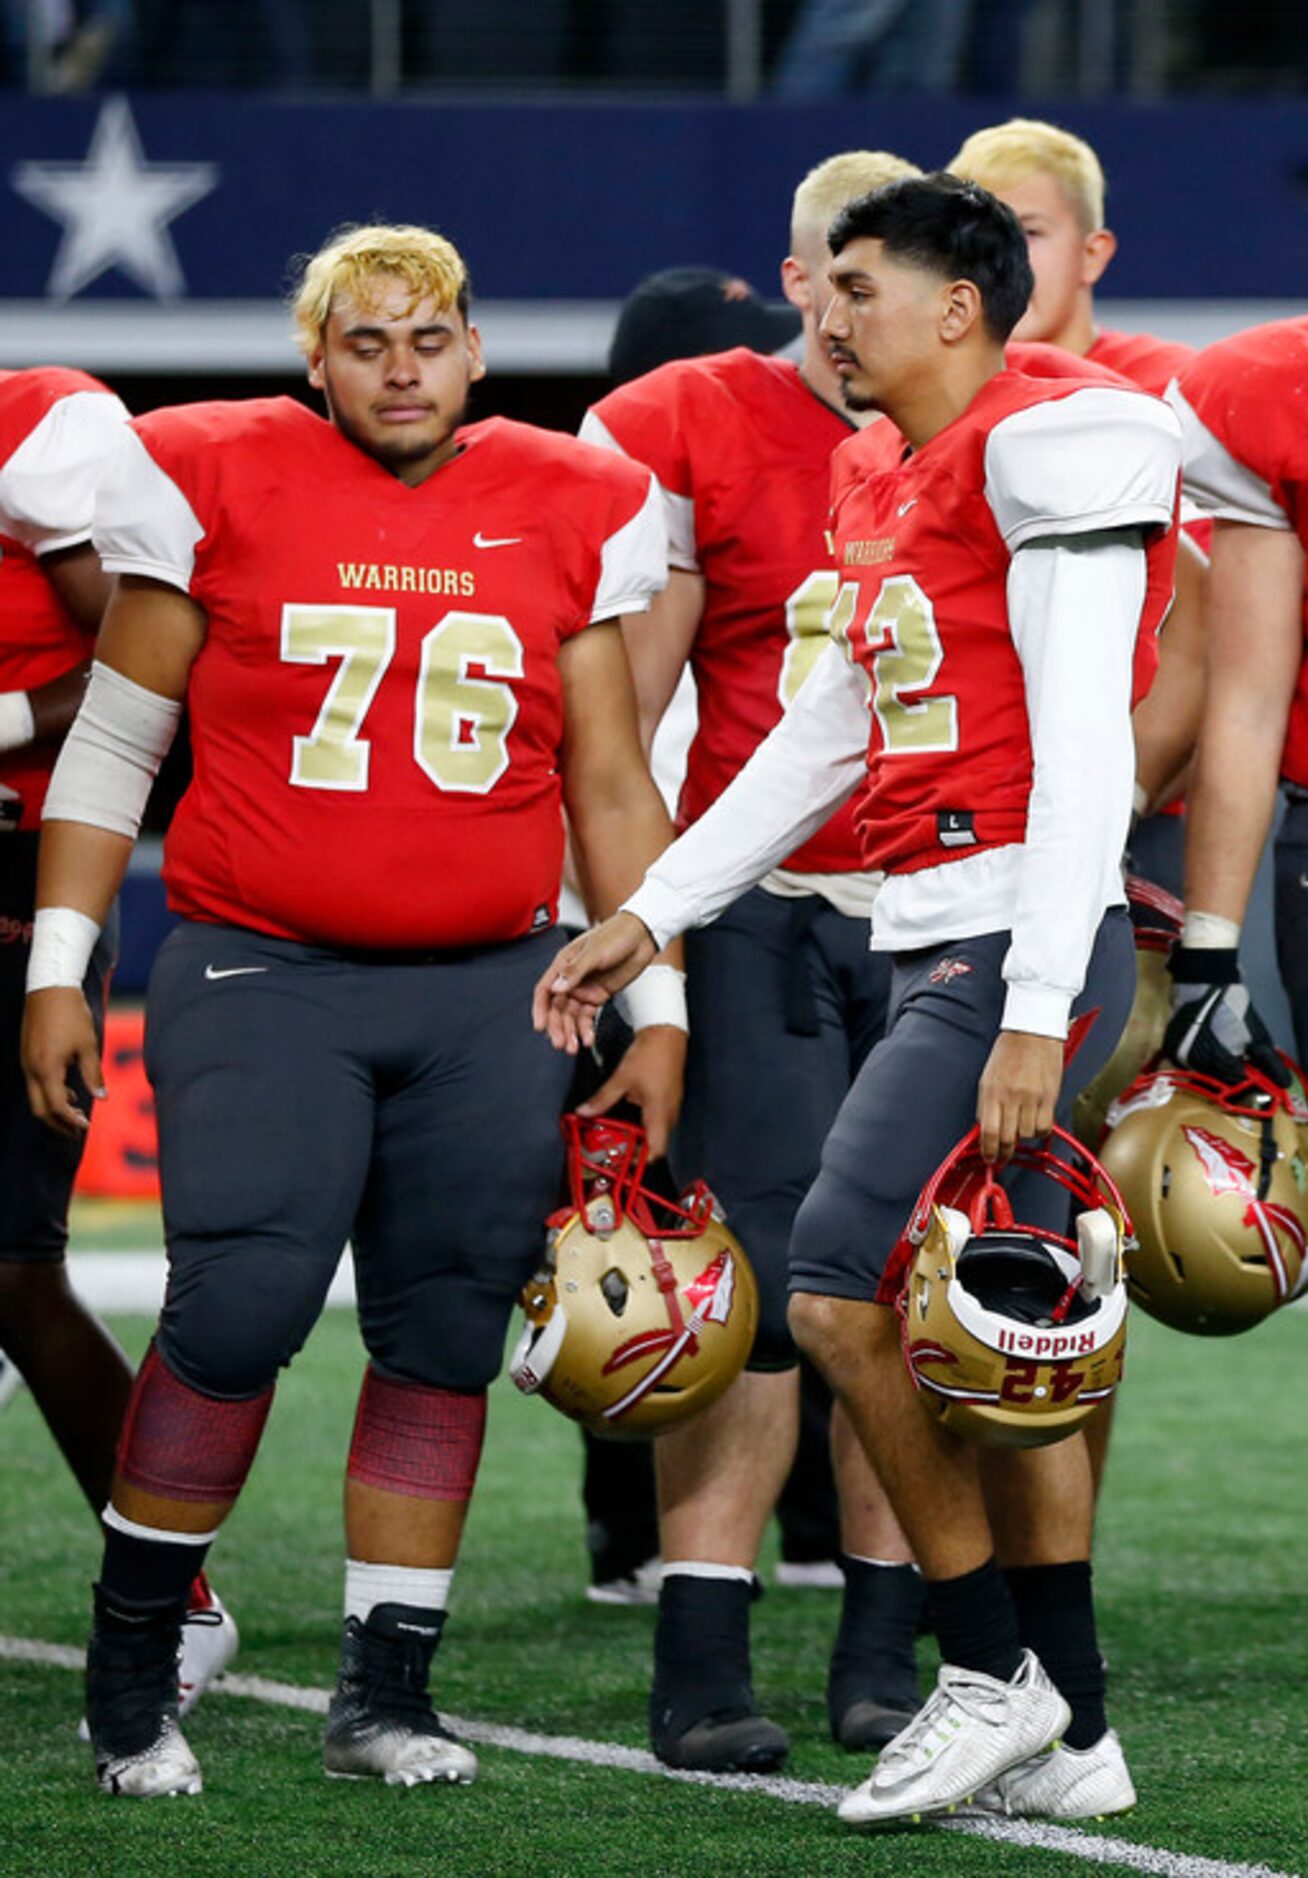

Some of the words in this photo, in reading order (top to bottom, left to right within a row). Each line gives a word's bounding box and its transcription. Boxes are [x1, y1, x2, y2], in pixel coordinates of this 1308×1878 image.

[336, 562, 475, 597] WARRIORS
[279, 602, 525, 795] 76
[949, 814, 960, 829] L
[998, 1328, 1096, 1357] Riddell
[1000, 1357, 1086, 1405] 42
